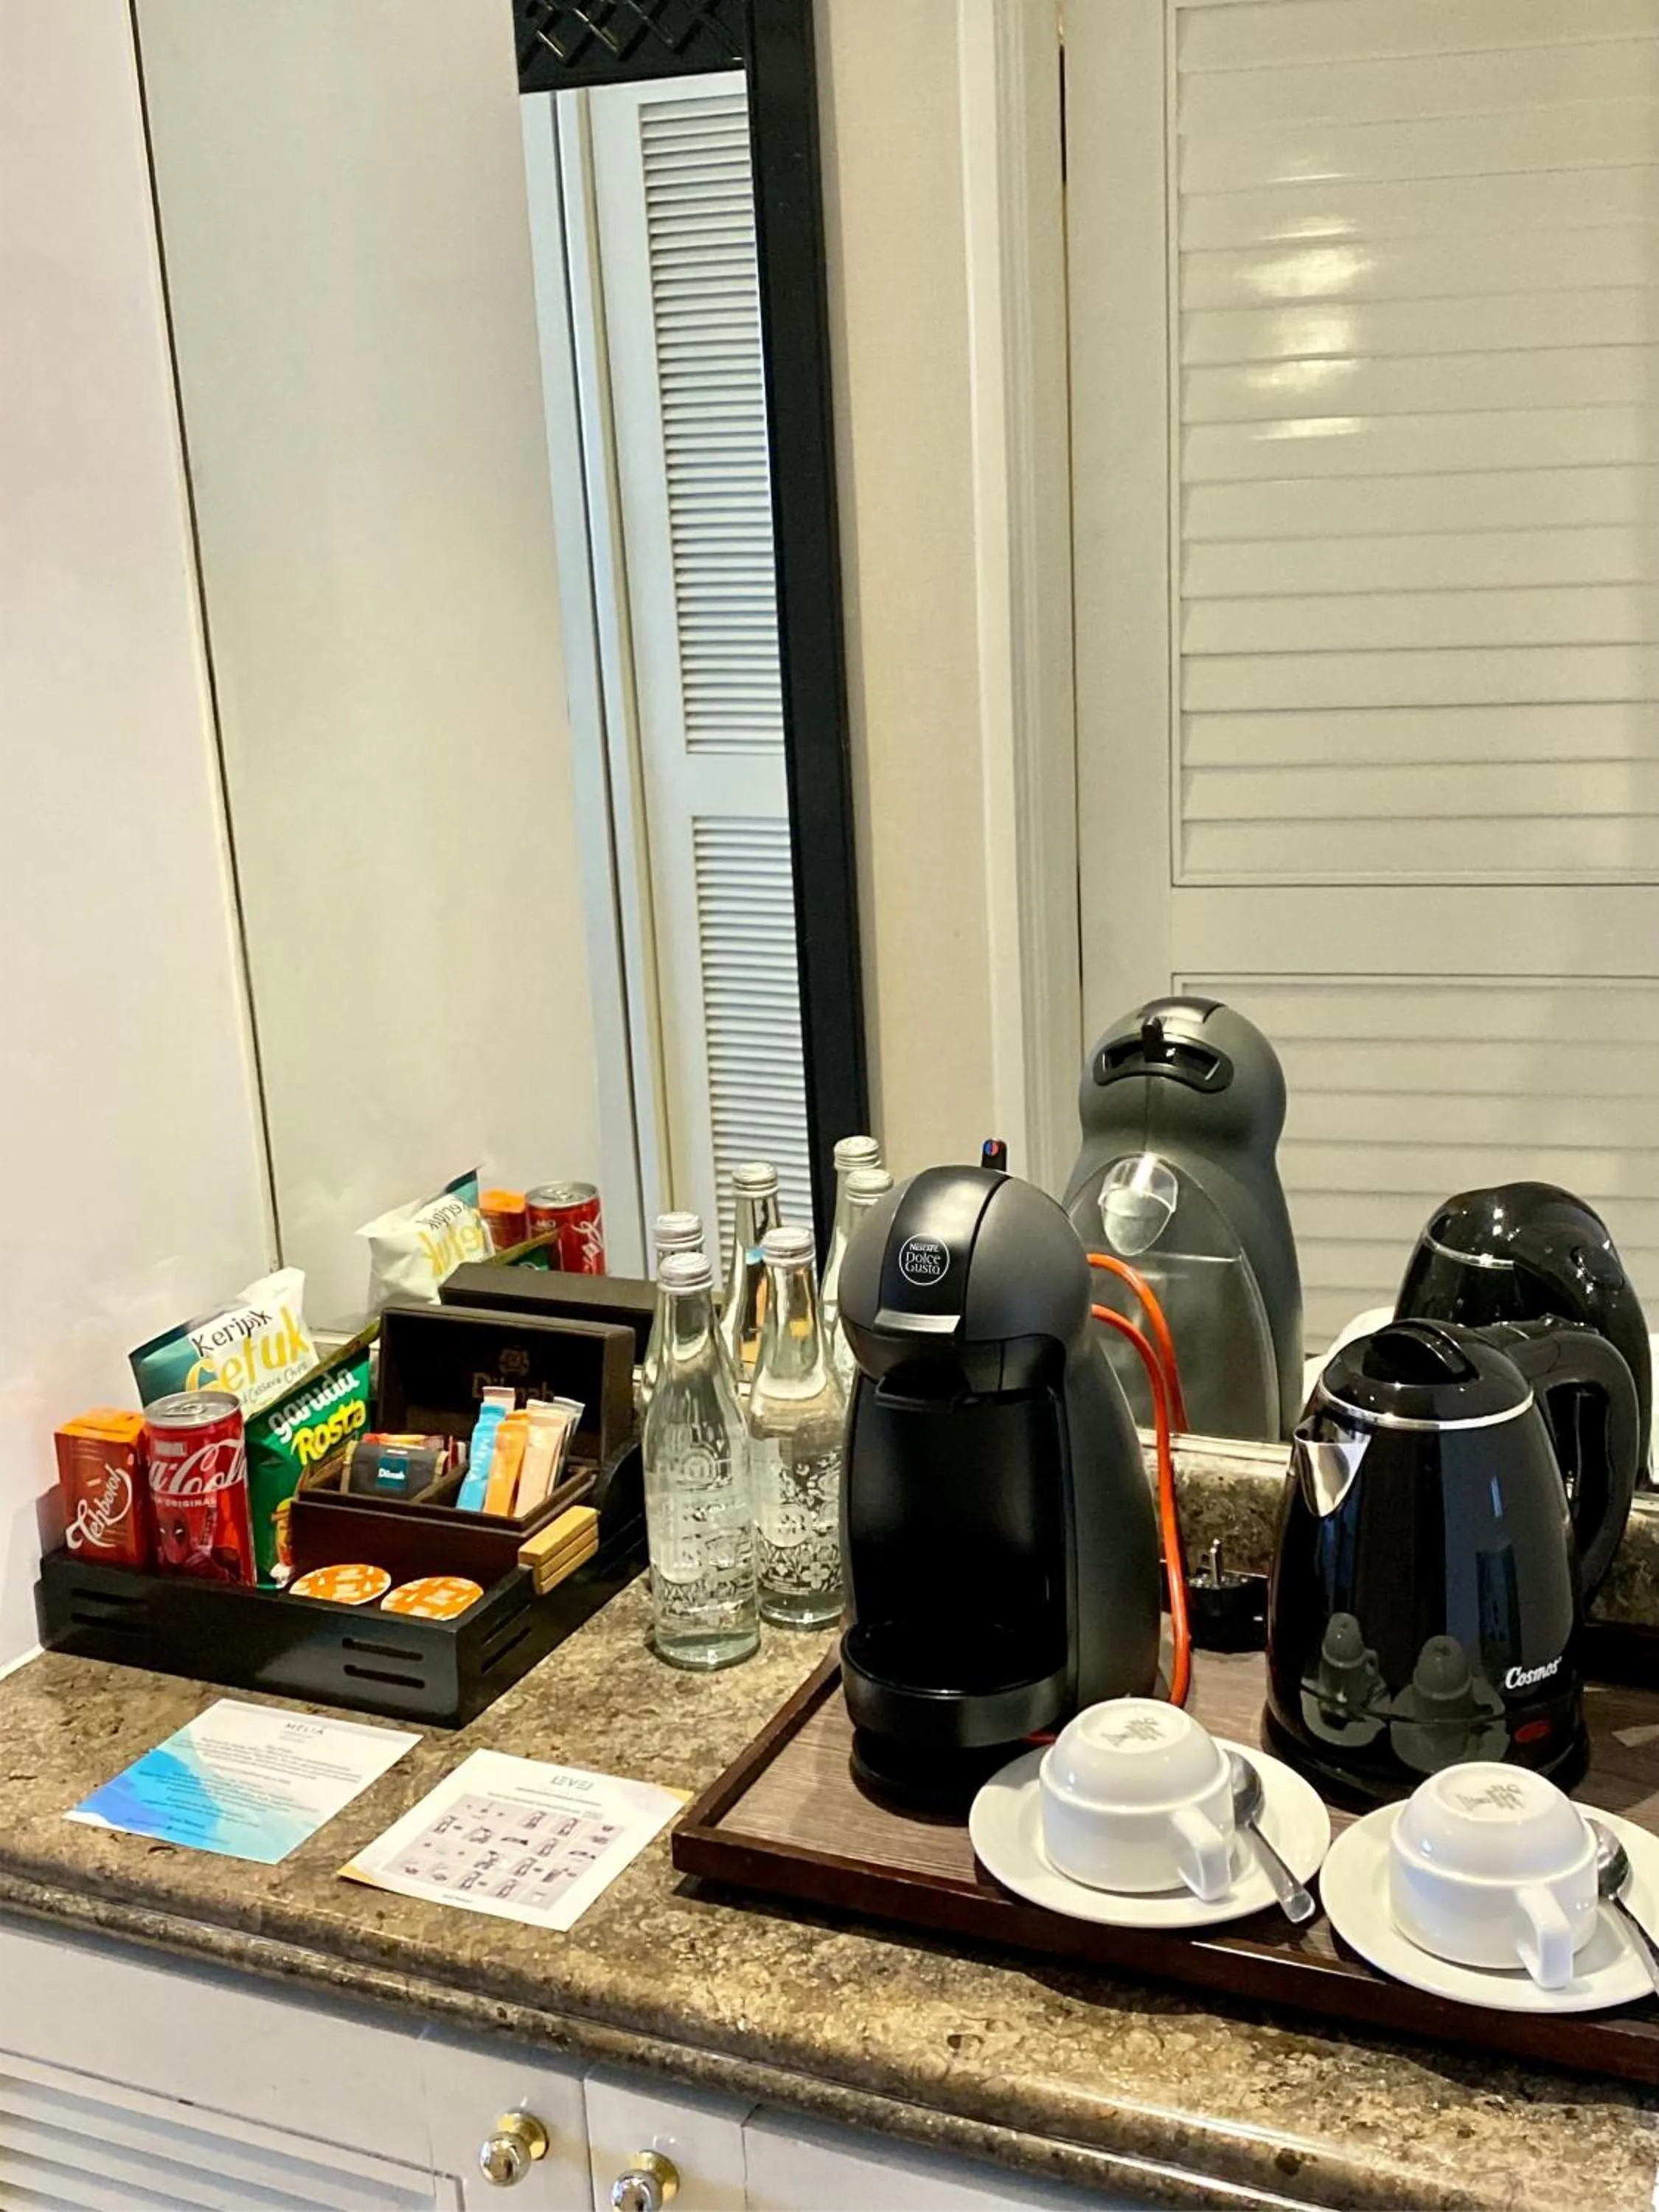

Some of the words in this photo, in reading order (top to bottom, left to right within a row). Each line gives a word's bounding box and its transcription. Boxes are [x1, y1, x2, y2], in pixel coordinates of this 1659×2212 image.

[905, 1262, 940, 1275] Gusto
[906, 1252, 942, 1265] Dolce
[192, 1307, 272, 1356] Keripik
[268, 1368, 361, 1444] garuda
[290, 1398, 366, 1465] Rosta
[1505, 1657, 1561, 1689] Cosmos
